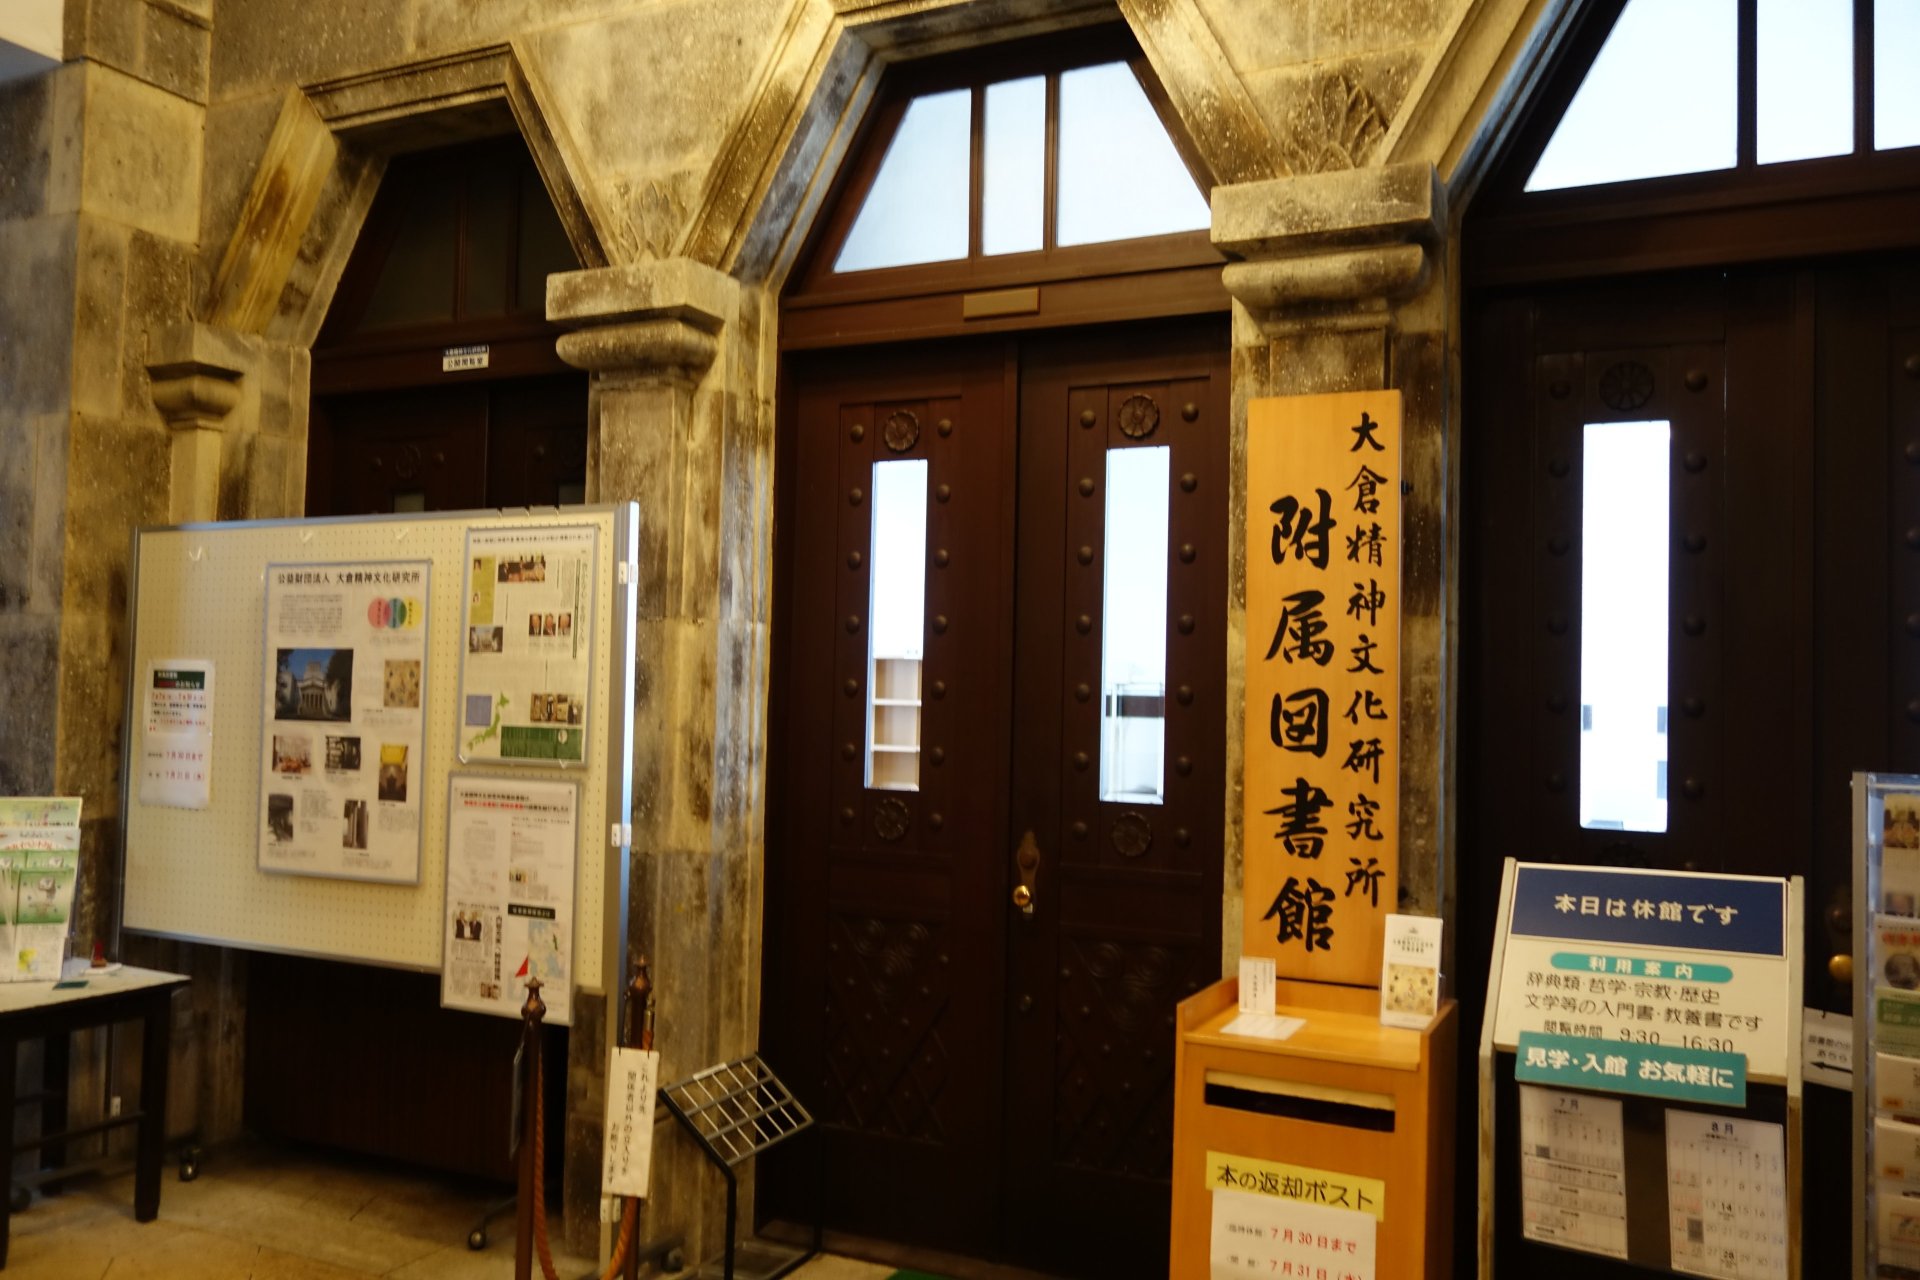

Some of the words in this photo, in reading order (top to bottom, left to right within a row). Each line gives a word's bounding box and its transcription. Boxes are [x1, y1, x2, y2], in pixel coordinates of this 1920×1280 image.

[278, 573, 330, 585] 公益財団法人
[336, 571, 420, 585] 大倉精神文化研究所
[1341, 412, 1388, 908] 大倉精神文化研究所
[1260, 487, 1337, 952] 附属図書館
[1554, 893, 1739, 927] 本日は休館です
[1588, 955, 1694, 979] 利用案内
[1525, 1046, 1628, 1077] 見学・入館
[1639, 1059, 1735, 1090] お気軽に
[1217, 1164, 1374, 1211] 本の返却ポスト
[1721, 1202, 1732, 1212] 14
[1270, 1227, 1357, 1254] 7月30日まで
